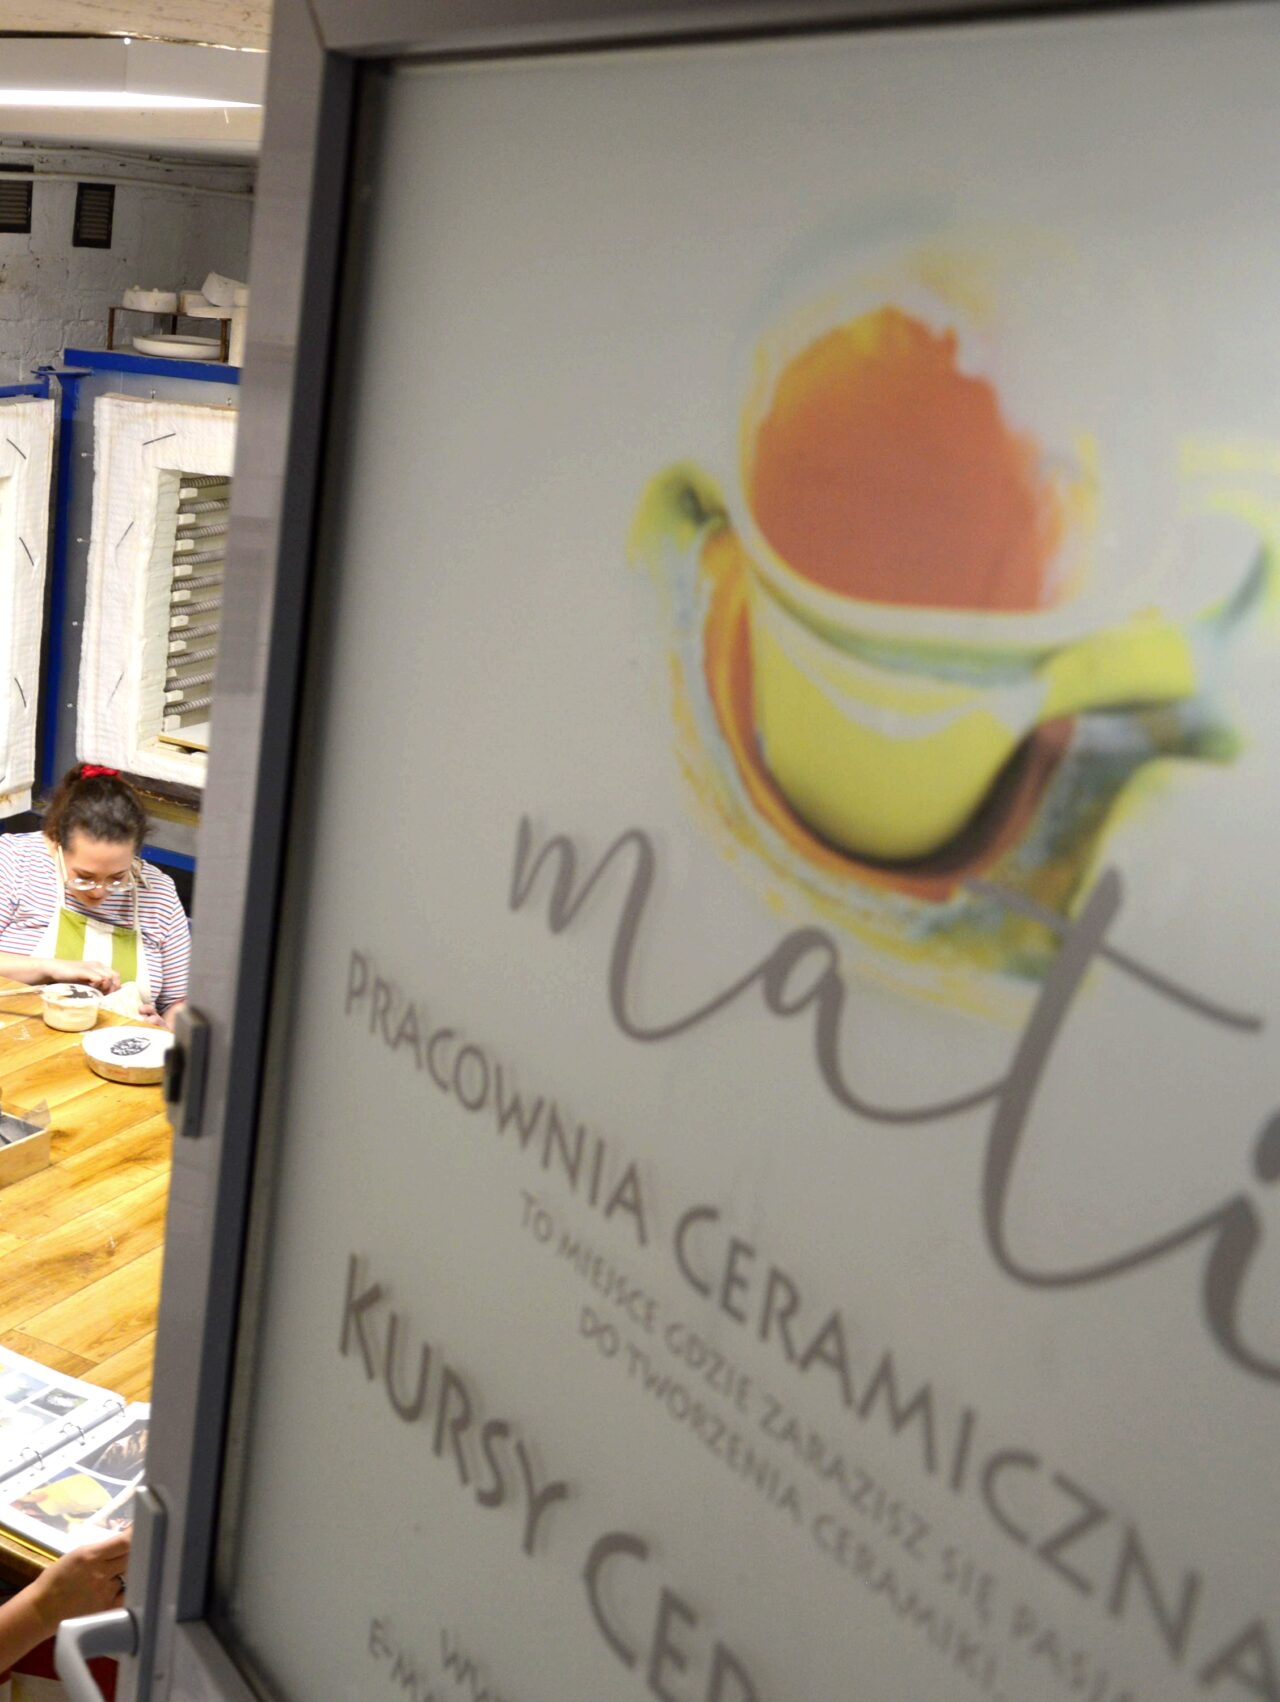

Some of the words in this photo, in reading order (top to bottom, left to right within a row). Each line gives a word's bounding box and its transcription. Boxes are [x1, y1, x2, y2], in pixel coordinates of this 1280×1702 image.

[342, 948, 650, 1248] PRACOWNIA
[521, 1191, 554, 1244] TO
[339, 1252, 570, 1558] KURSY
[580, 1305, 620, 1360] DO
